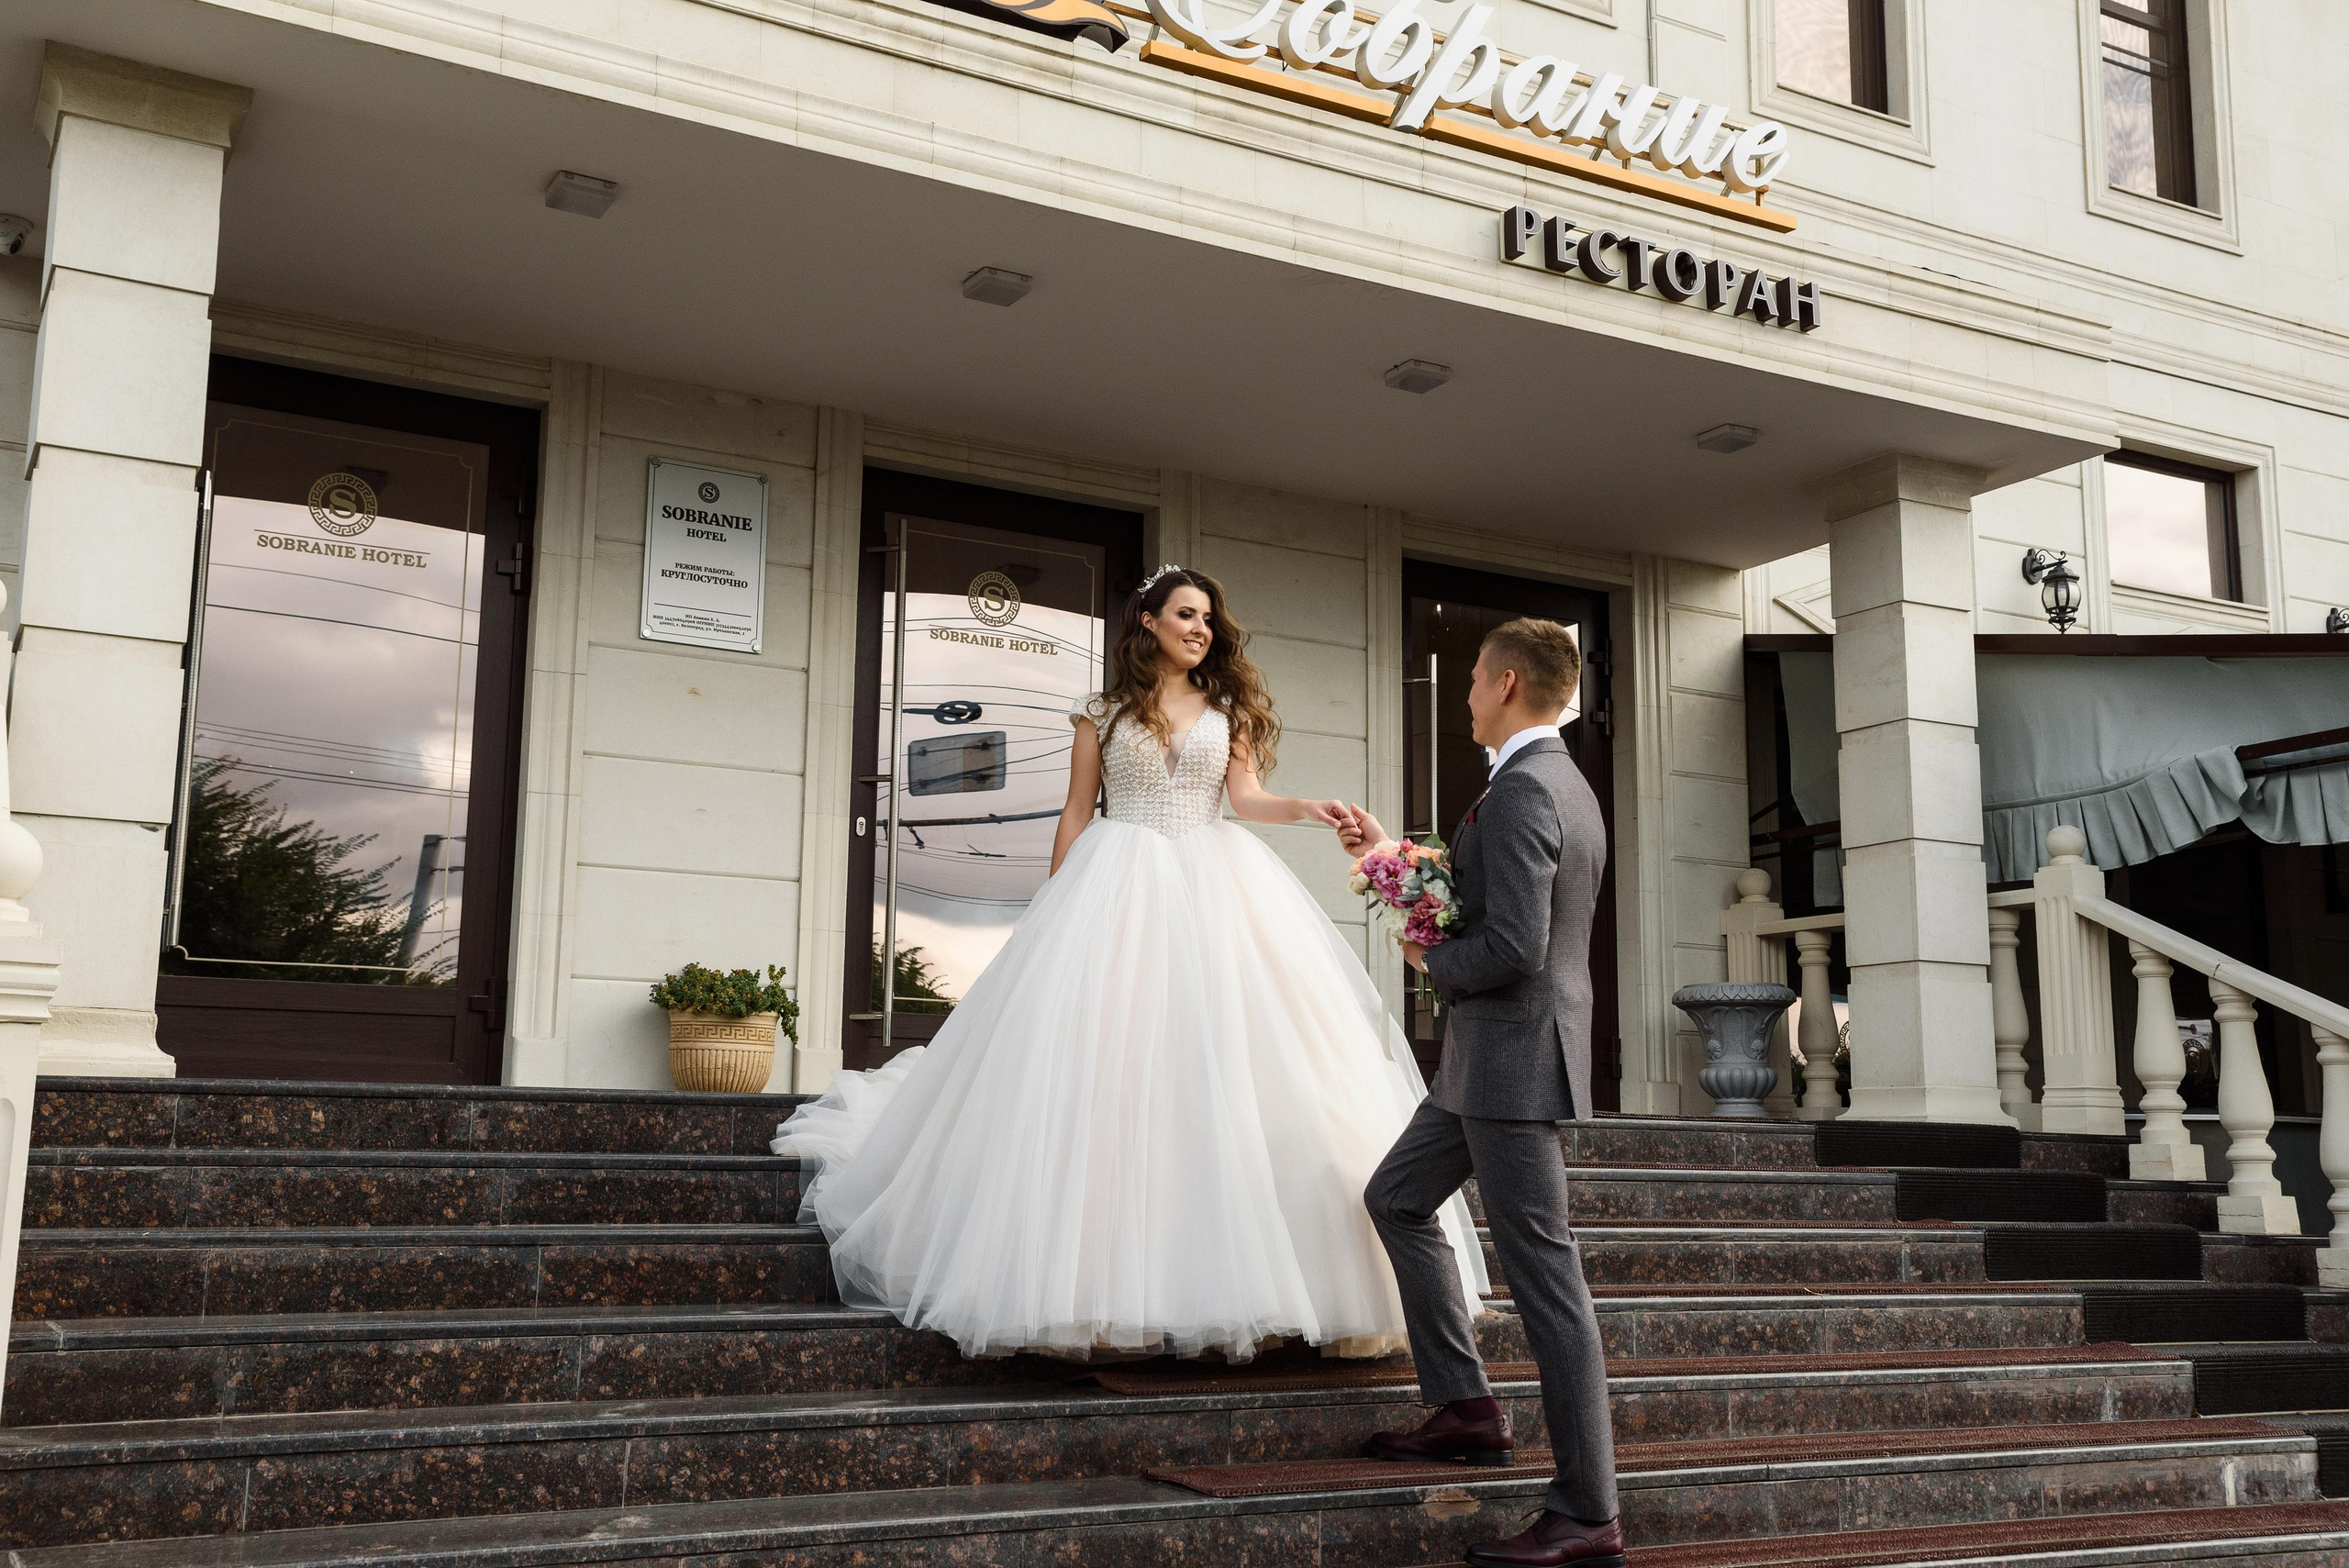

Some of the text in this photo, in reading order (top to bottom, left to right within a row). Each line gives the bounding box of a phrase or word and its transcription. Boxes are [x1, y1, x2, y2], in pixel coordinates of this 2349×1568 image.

[1503, 205, 1821, 332] РЕСТОРАН
[662, 505, 752, 531] SOBRANIE
[686, 528, 727, 542] HOTEL
[256, 534, 428, 569] SOBRANIE HOTEL
[661, 569, 748, 588] КРУГЛОСУТОЧНО
[674, 562, 736, 577] РЕЖИМ РАБОТЫ:
[930, 628, 1059, 656] SOBRANIE HOTEL
